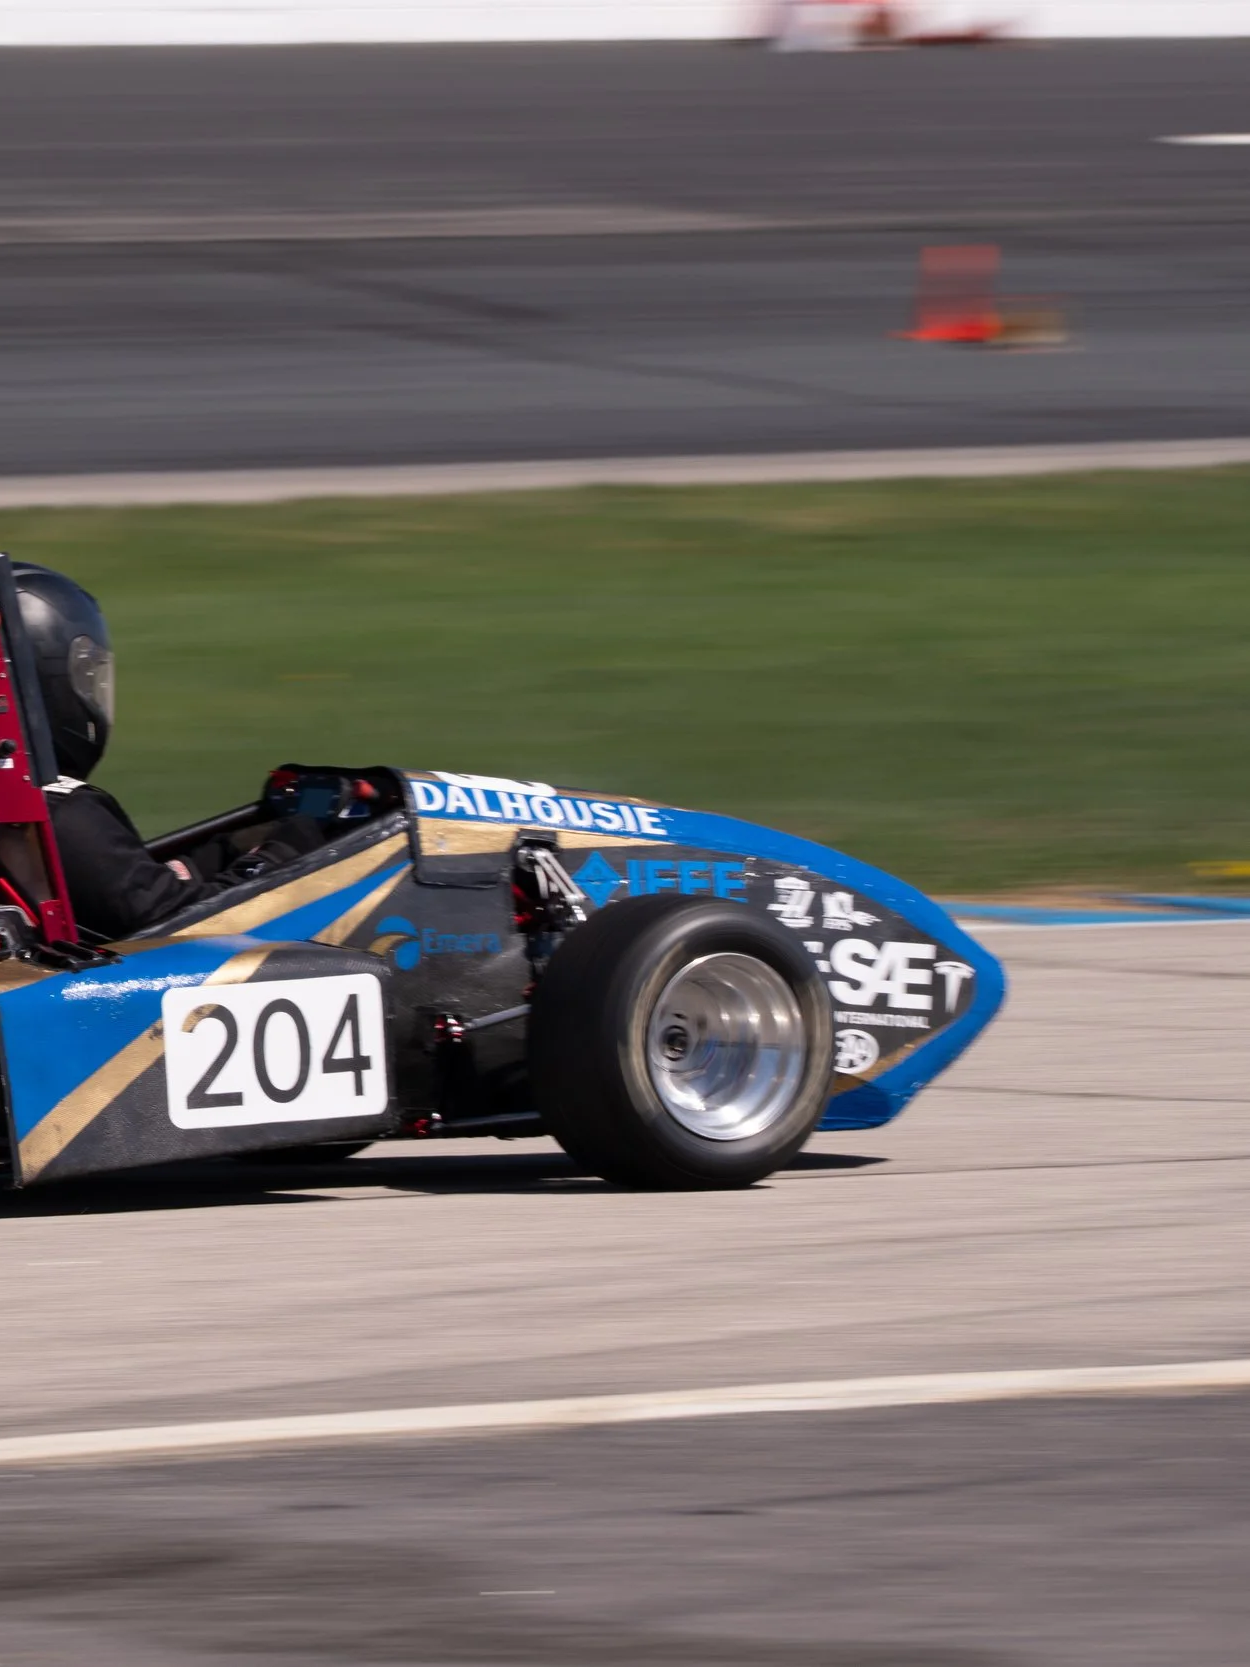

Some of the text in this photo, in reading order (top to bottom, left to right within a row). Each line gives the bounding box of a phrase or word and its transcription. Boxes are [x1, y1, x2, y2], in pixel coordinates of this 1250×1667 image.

[410, 781, 669, 835] DALHOUSIE
[422, 927, 502, 954] Emera
[181, 993, 372, 1110] 204
